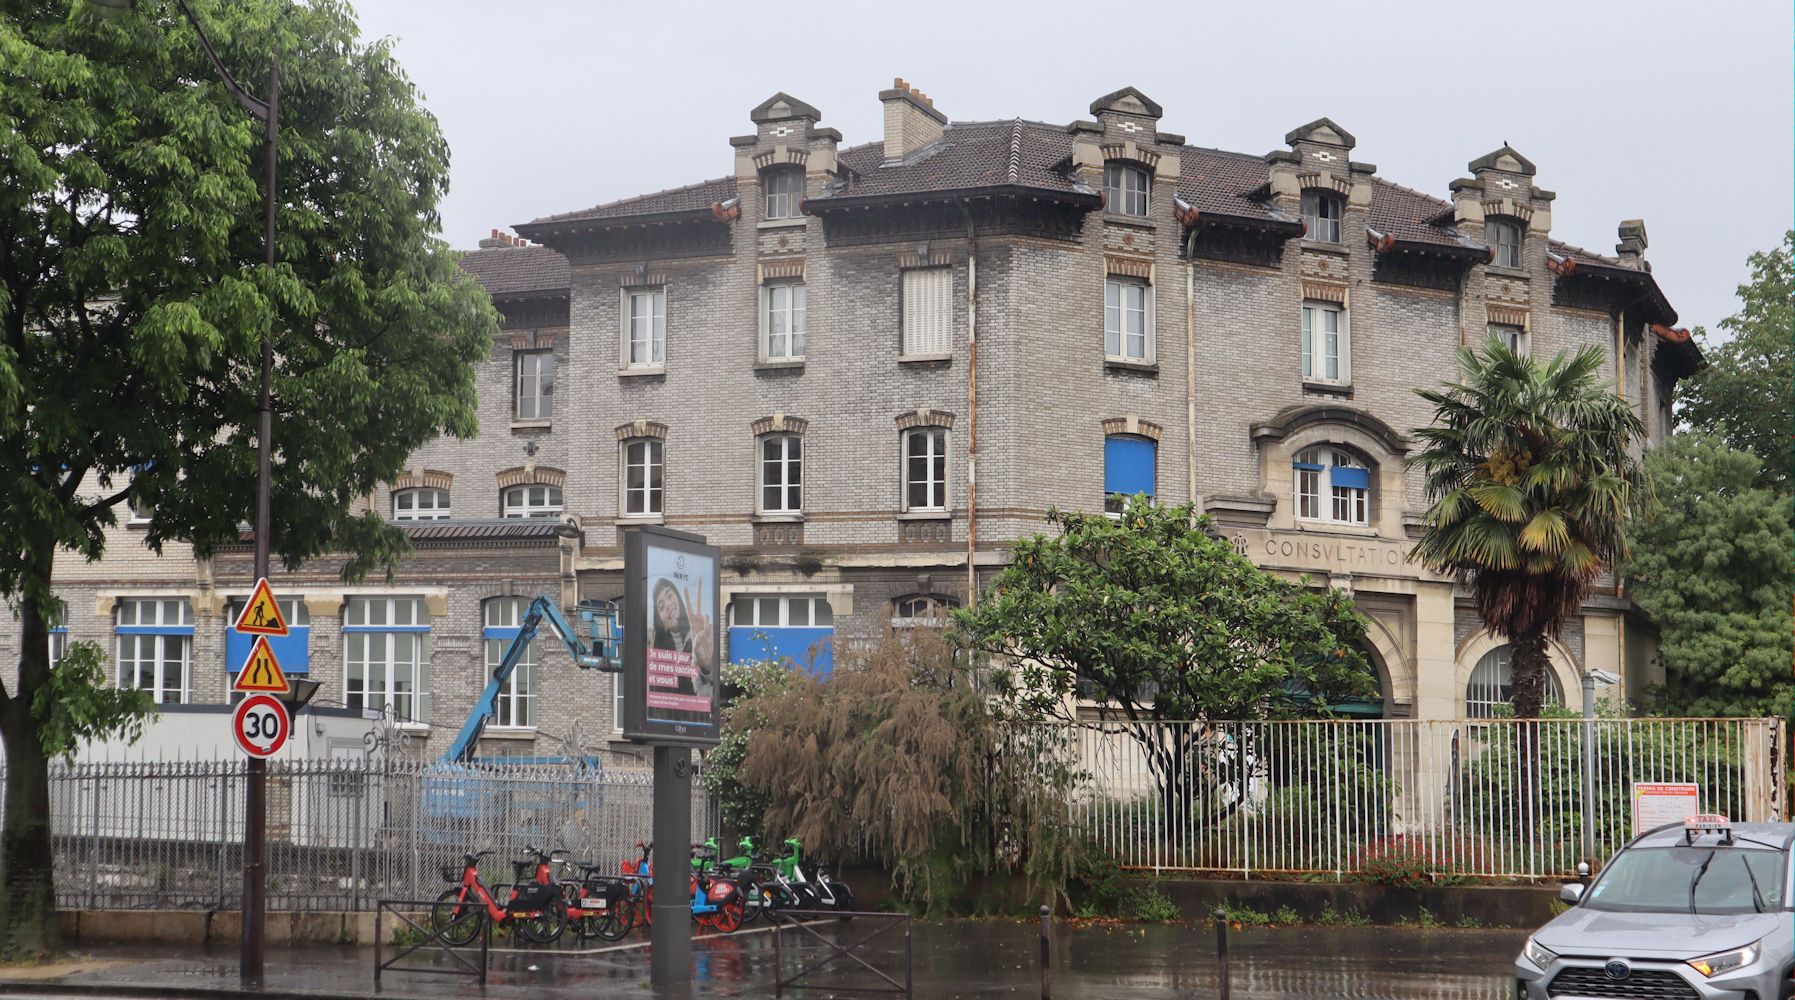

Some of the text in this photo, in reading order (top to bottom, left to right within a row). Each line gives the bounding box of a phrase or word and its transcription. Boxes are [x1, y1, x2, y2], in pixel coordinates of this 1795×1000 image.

[673, 571, 689, 581] PARIS
[650, 649, 656, 658] Je
[657, 650, 673, 660] suis
[677, 653, 690, 663] jour
[648, 661, 699, 677] de mes vaccins,
[648, 675, 656, 684] et
[245, 712, 278, 739] 30
